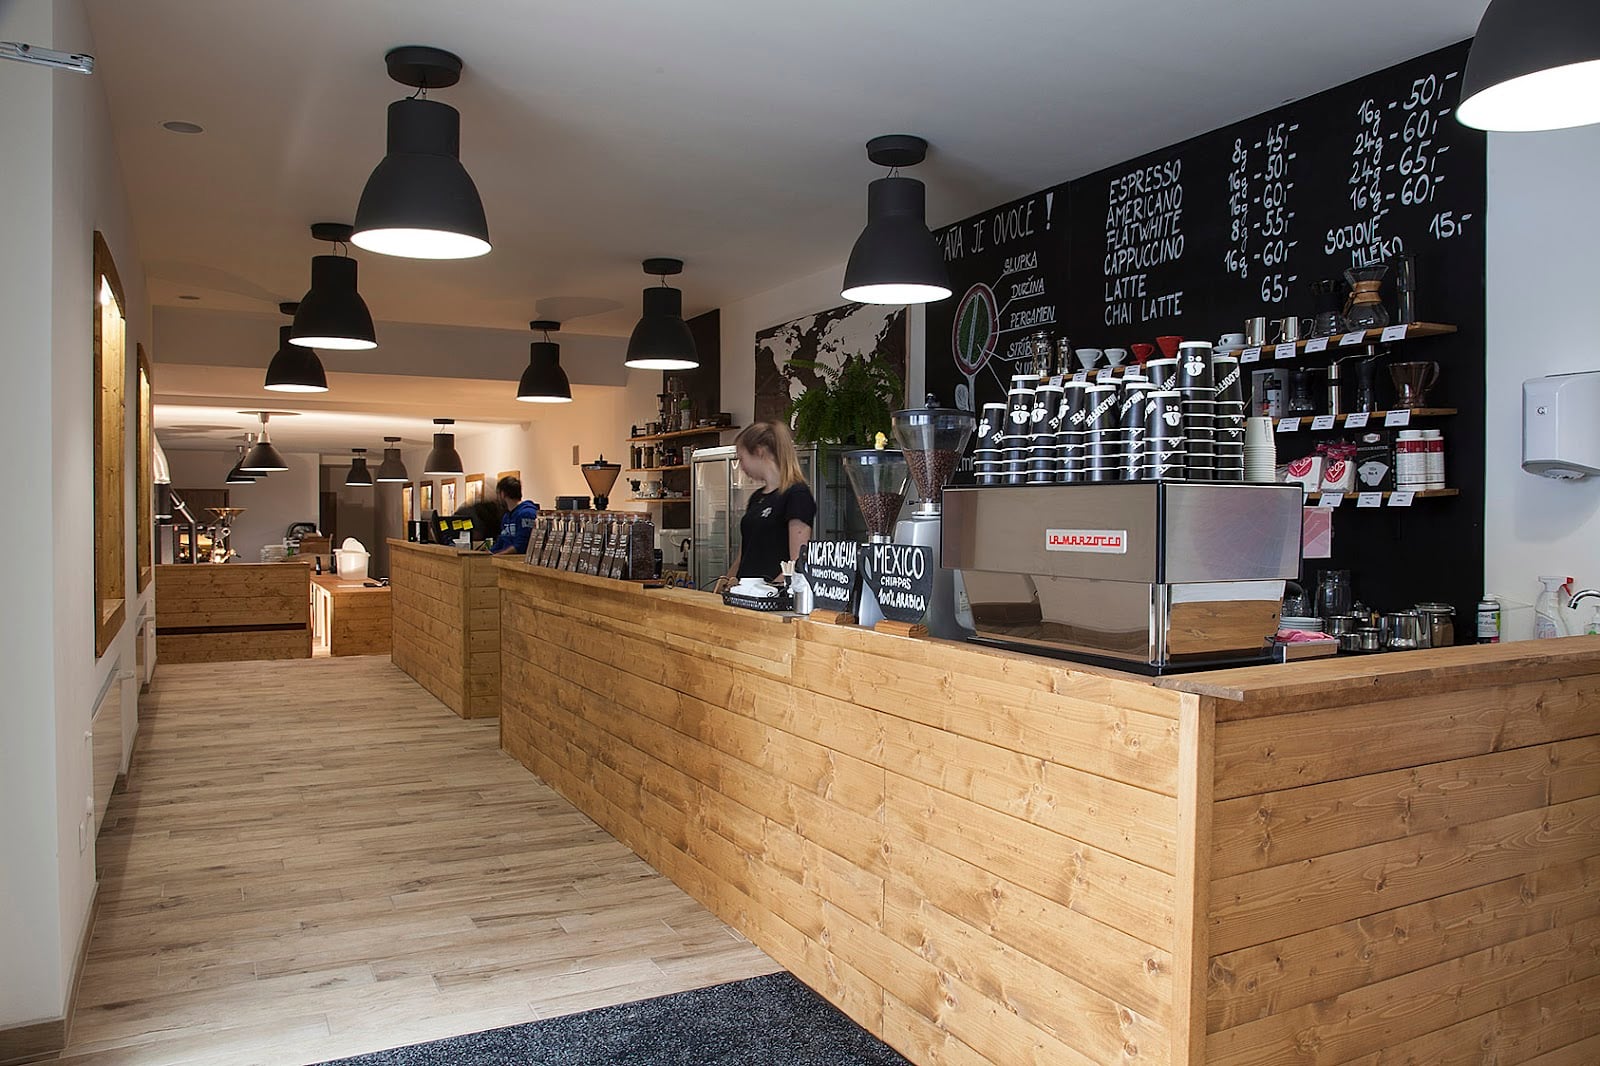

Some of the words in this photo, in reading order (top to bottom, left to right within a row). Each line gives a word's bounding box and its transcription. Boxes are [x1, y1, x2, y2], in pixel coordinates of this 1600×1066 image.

[1357, 99, 1381, 136] 16g
[1353, 130, 1383, 165] 24g
[1109, 158, 1181, 205] ESPRESSO
[1232, 138, 1247, 172] 8g
[1349, 157, 1382, 199] 24g
[1105, 183, 1183, 230] AMERICANO
[1228, 169, 1248, 199] 16g
[1350, 185, 1382, 212] 16g
[971, 219, 985, 253] JE
[993, 200, 1035, 245] OVOCE
[1106, 209, 1183, 251] FLATWHITE
[1229, 191, 1248, 226] 16g
[1003, 250, 1037, 274] SLUPKA
[1104, 234, 1184, 275] CAPPUCCINO
[1231, 218, 1248, 253] 8g
[1105, 274, 1147, 302] LATTE
[1224, 249, 1248, 279] 16g
[1010, 305, 1056, 328] PERGAMEN
[1104, 302, 1132, 326] CHAI
[1141, 291, 1183, 322] LATTE
[807, 541, 857, 571] NICARAGUA
[873, 545, 925, 580] MEXICO
[880, 575, 912, 590] CHIAPAS
[895, 592, 926, 612] ARABICA
